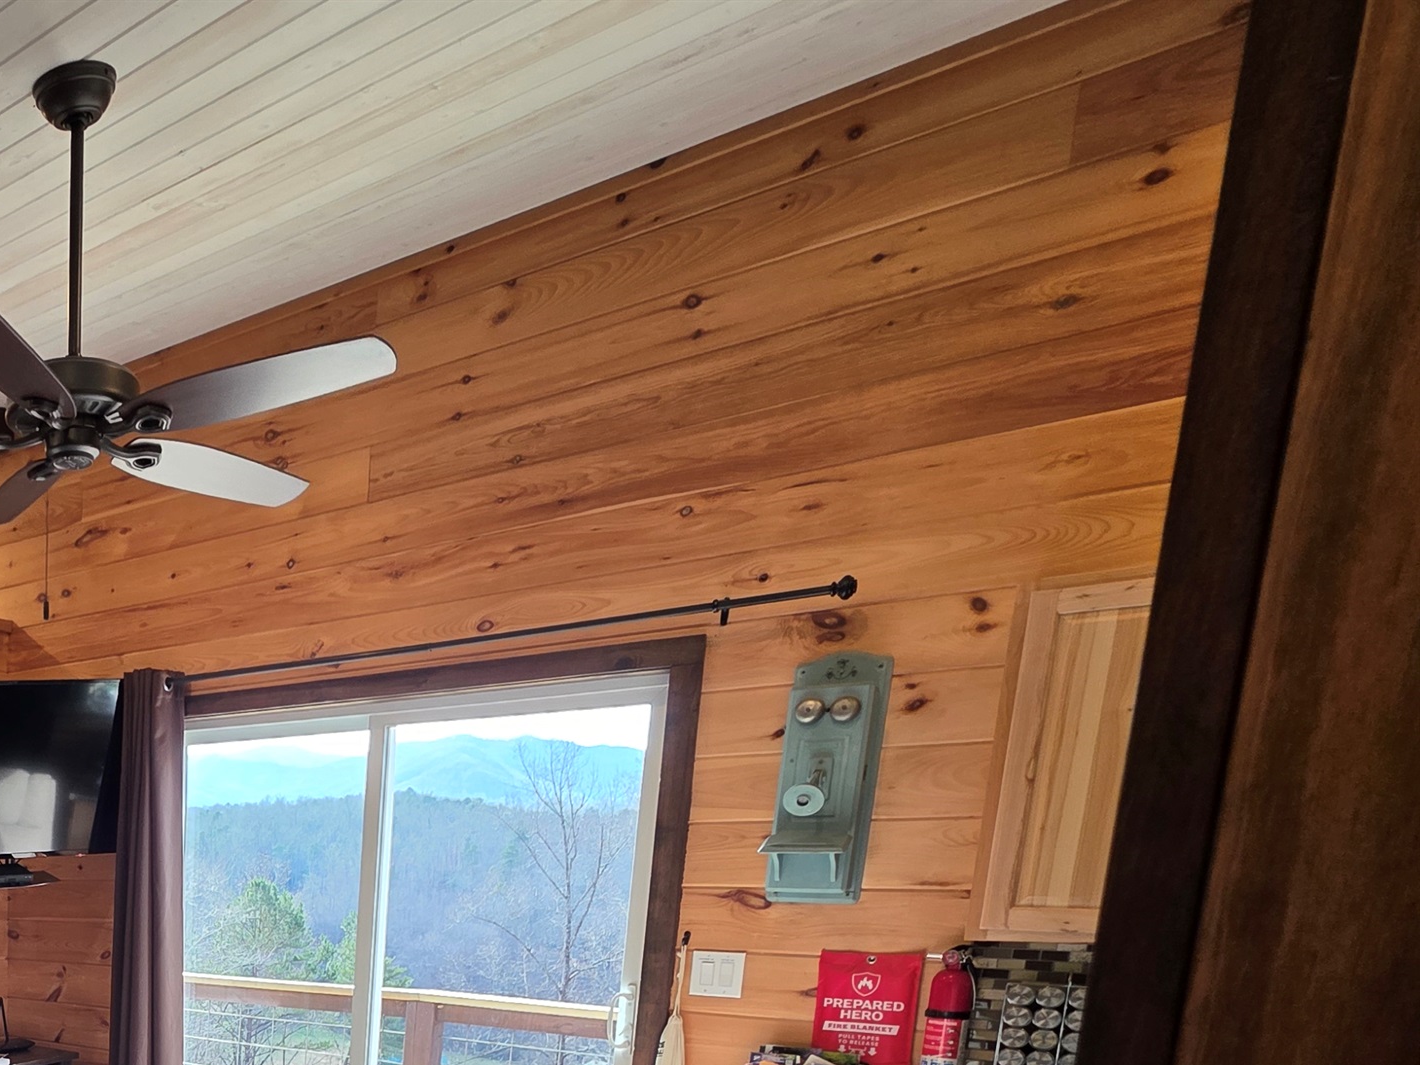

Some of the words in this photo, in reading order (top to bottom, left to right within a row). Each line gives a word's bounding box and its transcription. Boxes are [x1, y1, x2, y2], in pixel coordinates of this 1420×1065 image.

[823, 998, 905, 1011] PREPARED
[839, 1010, 883, 1021] HERO
[827, 1022, 849, 1030] FIRE
[850, 1023, 894, 1033] BLANKET
[849, 1039, 879, 1047] RELEASE
